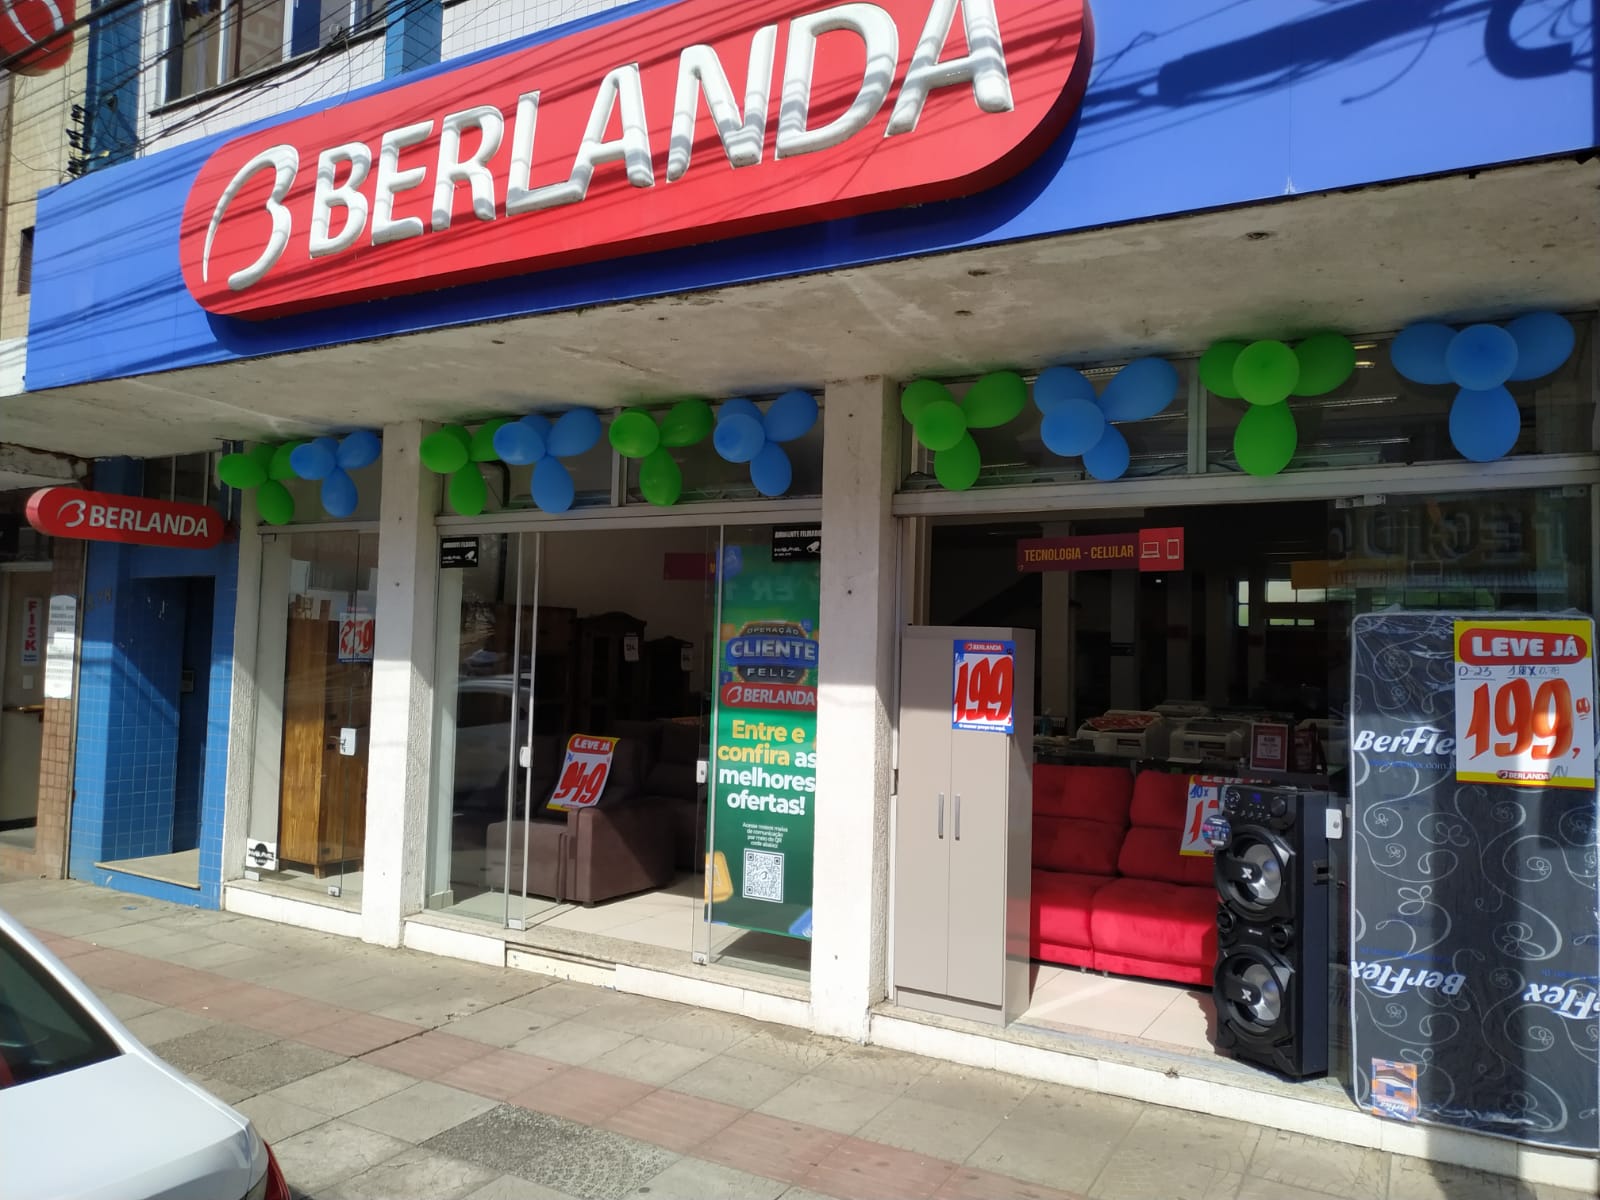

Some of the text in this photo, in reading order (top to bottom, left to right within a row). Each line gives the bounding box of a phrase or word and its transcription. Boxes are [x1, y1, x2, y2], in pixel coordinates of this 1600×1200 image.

[309, 0, 1014, 260] BERLANDA
[89, 505, 208, 537] BERLANDA
[1024, 549, 1081, 562] TECNOLOGIA
[1090, 545, 1134, 559] CELULAR
[24, 601, 38, 651] FISK
[746, 626, 799, 636] OPERAÇÃO
[730, 639, 816, 661] CLIENTE
[1471, 635, 1579, 657] LEVE JÁ
[746, 668, 796, 679] FELIZ
[743, 688, 816, 706] BERLANDA
[732, 719, 806, 744] Entre e
[1353, 726, 1456, 756] BerFle
[573, 738, 600, 751] LEVE
[717, 743, 791, 766] confira
[719, 767, 816, 793] melhores
[727, 789, 806, 816] ofertas!
